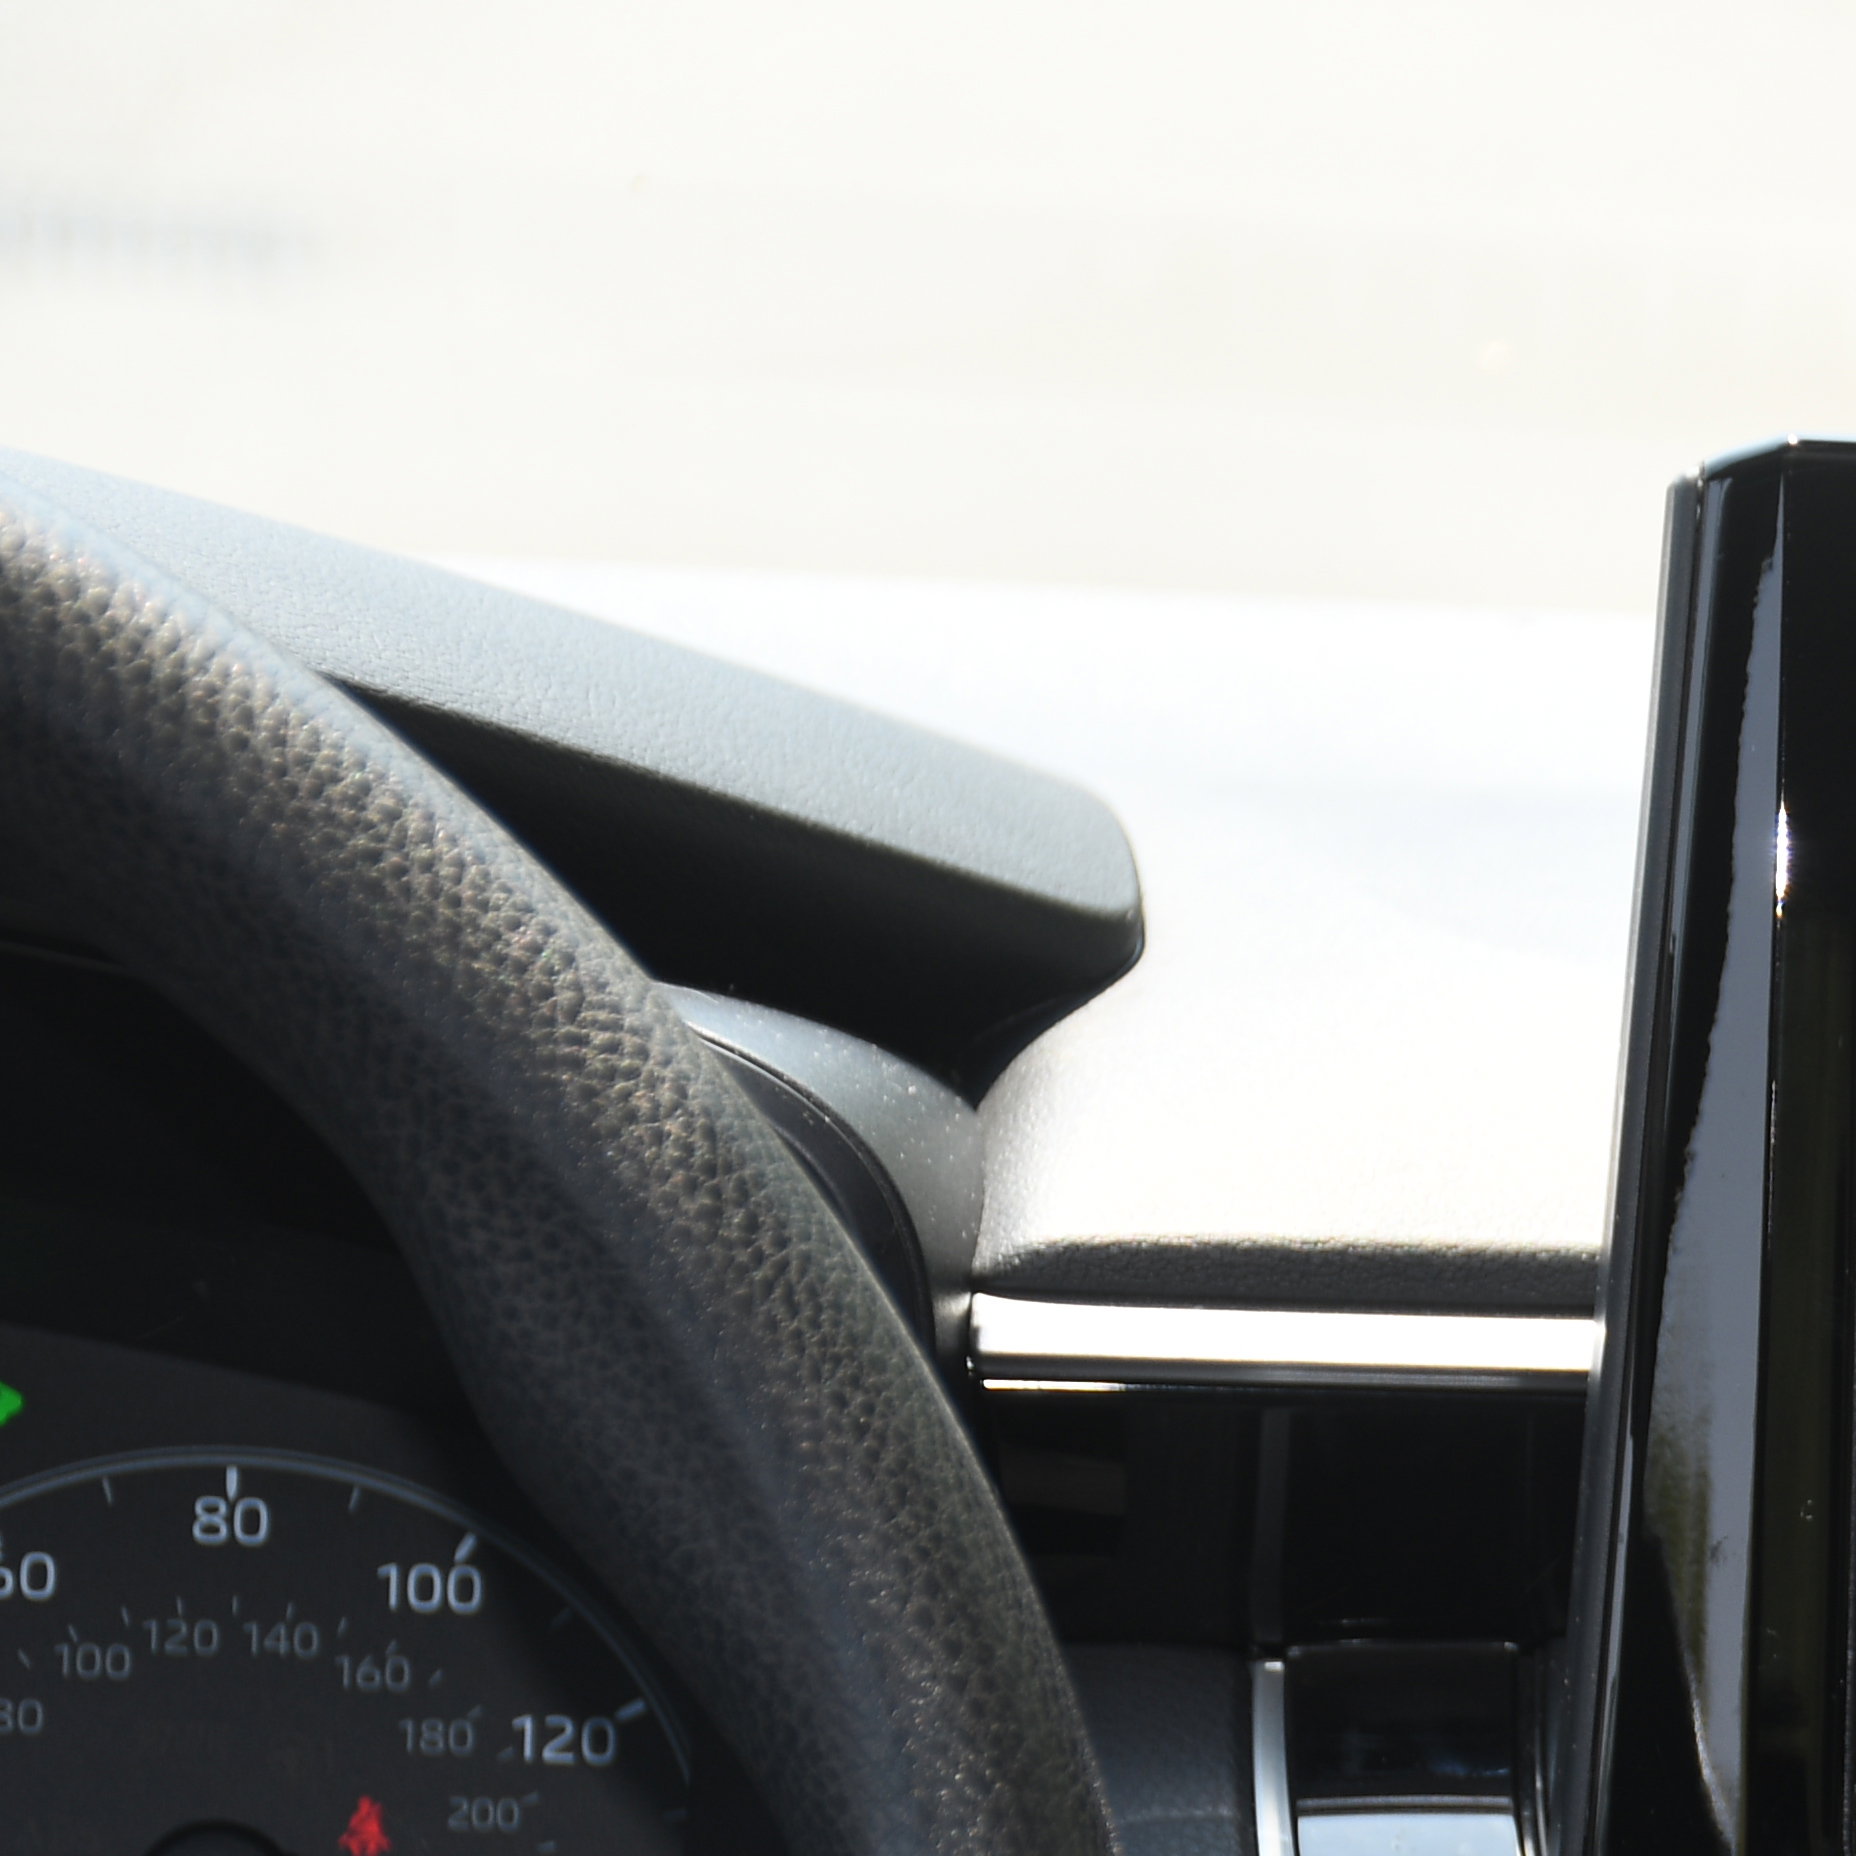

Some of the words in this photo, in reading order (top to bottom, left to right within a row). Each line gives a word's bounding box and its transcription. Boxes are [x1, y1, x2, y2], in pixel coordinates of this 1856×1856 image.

[193, 1497, 268, 1544] 80
[379, 1564, 481, 1612] 100
[147, 1620, 219, 1653] 120
[246, 1623, 319, 1657] 140
[58, 1644, 131, 1678] 100
[336, 1657, 410, 1689] 160
[402, 1720, 474, 1753] 180
[513, 1715, 612, 1763] 120
[449, 1798, 519, 1828] 200
